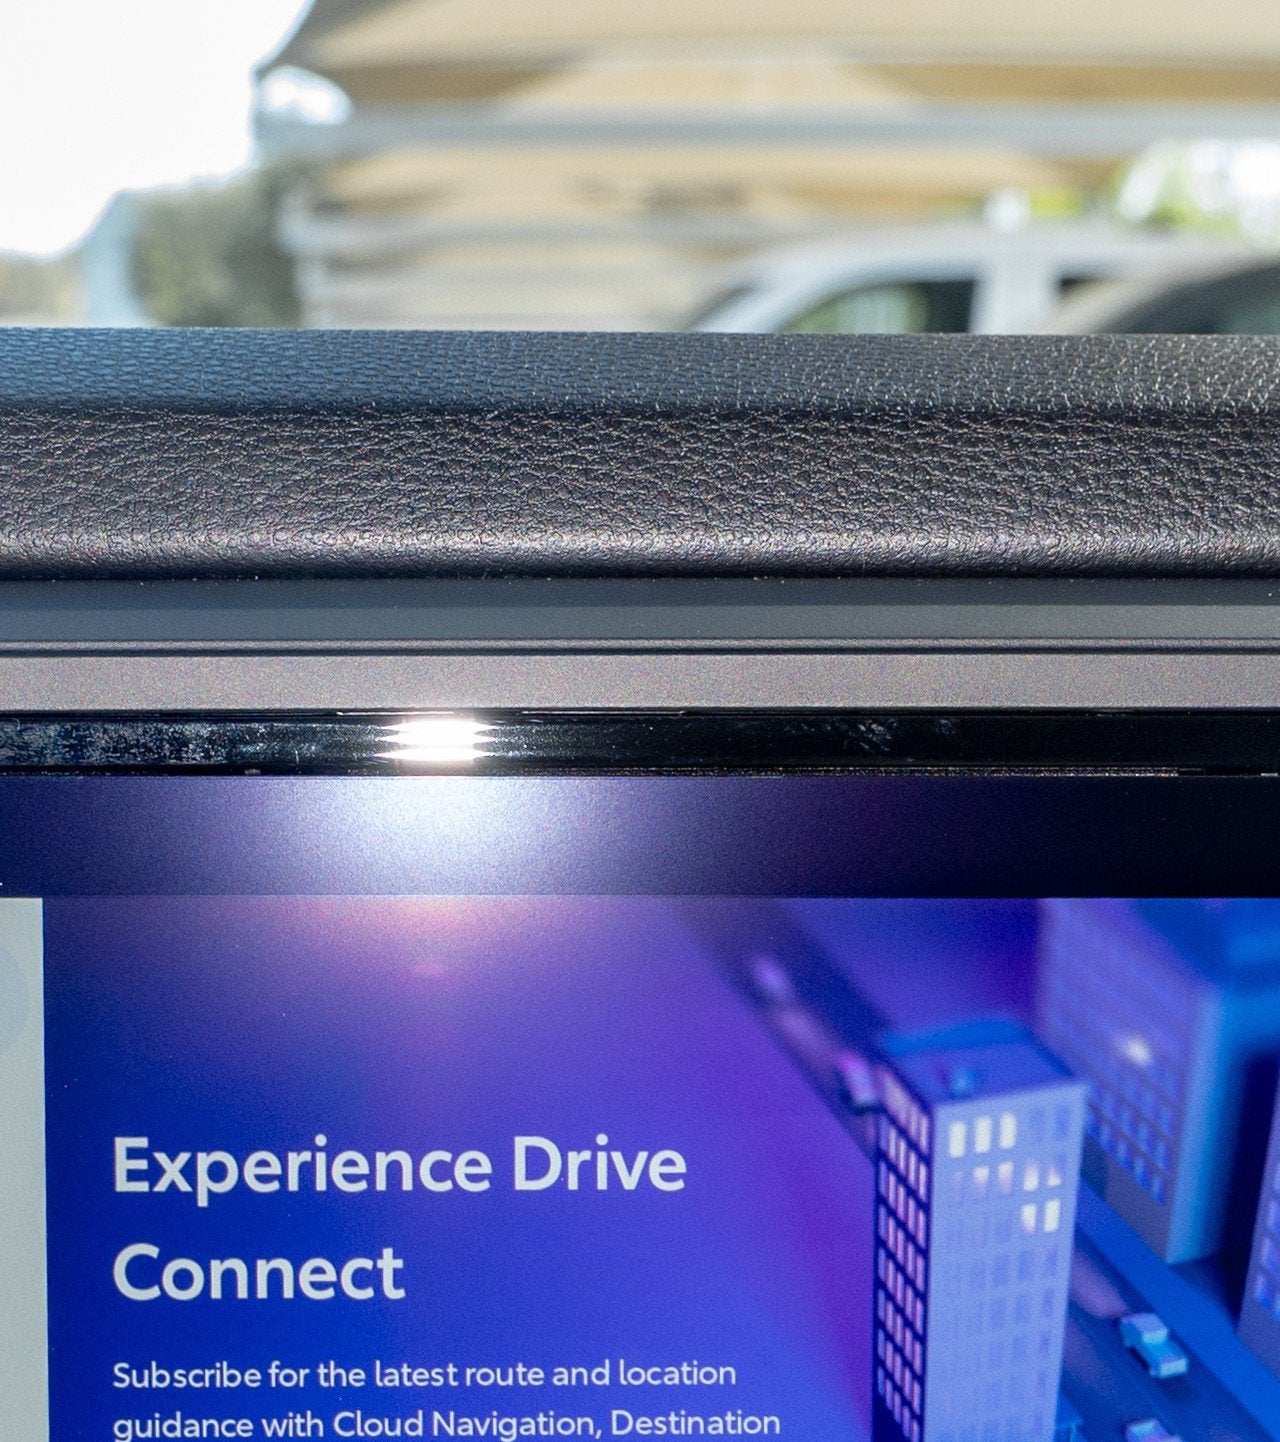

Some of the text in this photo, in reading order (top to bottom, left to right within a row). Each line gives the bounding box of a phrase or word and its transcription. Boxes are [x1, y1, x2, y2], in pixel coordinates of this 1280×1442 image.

[112, 1132, 688, 1208] Experience Drive
[111, 1242, 407, 1302] Connect
[112, 1359, 738, 1389] Subscribe for the latest route and location
[261, 1411, 324, 1439] with
[332, 1410, 424, 1439] Cloud
[431, 1409, 603, 1442] Navigation,
[610, 1409, 782, 1438] Destination
